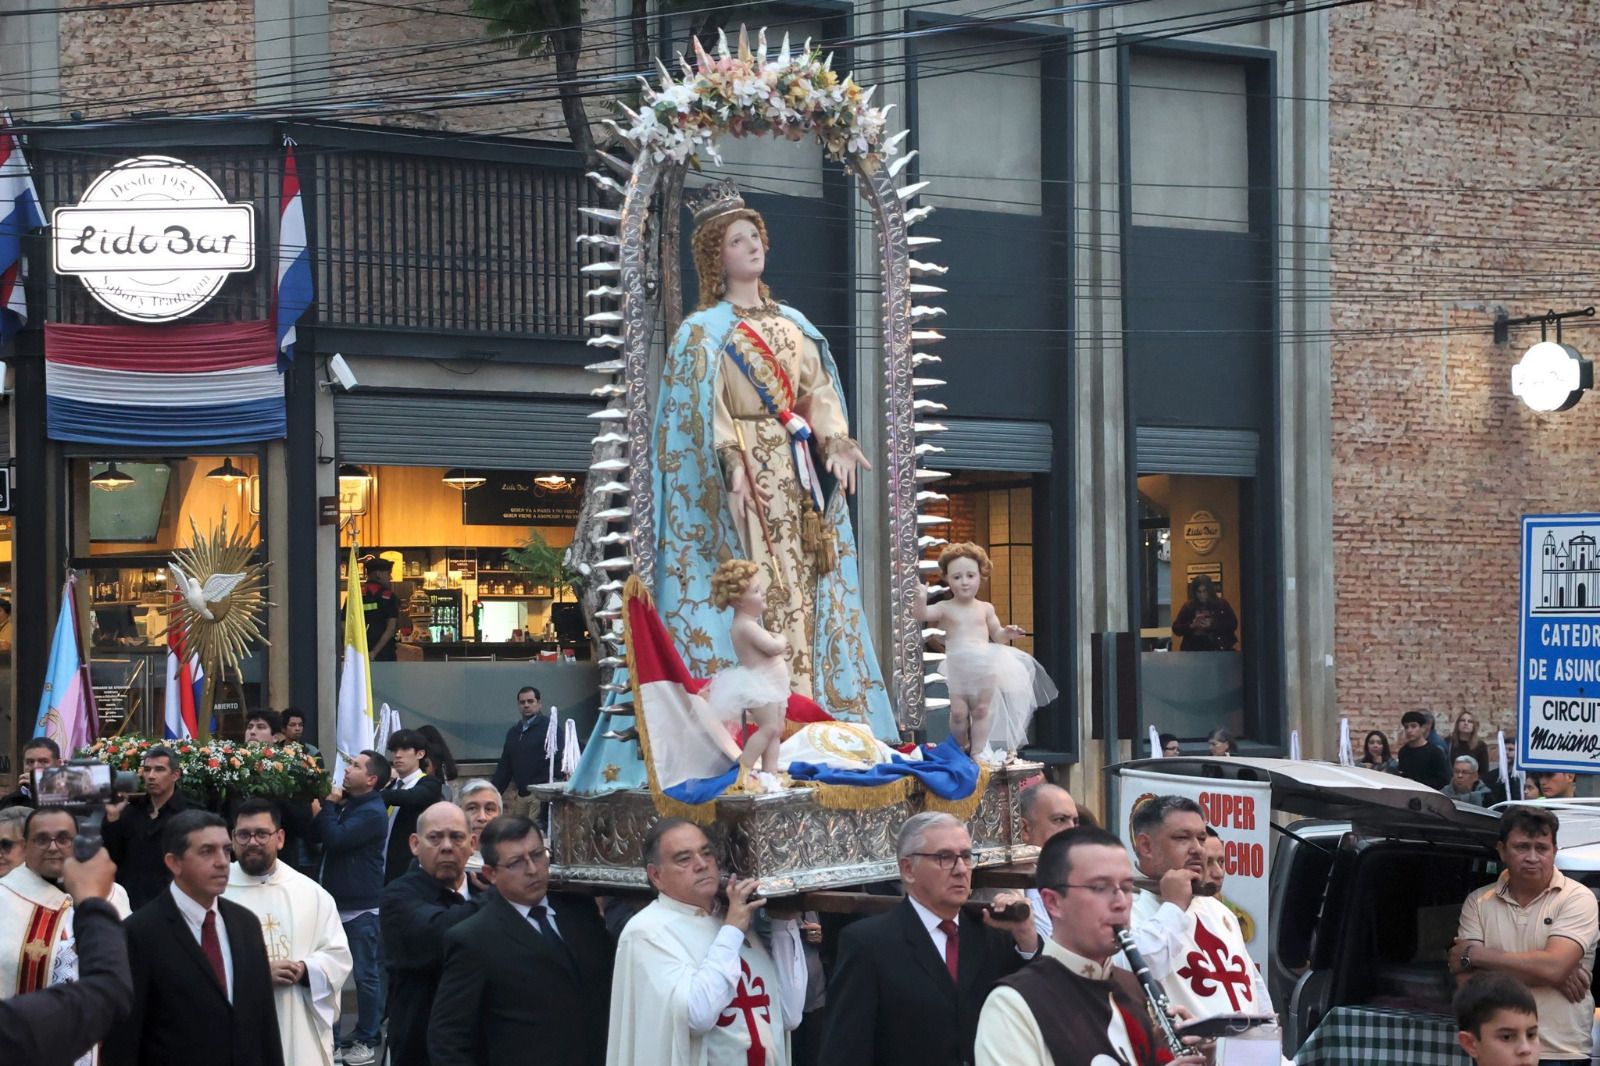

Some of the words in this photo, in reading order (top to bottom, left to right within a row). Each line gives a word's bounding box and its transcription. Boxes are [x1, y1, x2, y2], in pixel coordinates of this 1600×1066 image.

[110, 173, 154, 198] Desde
[70, 225, 158, 255] Lido
[163, 225, 237, 255] Bar
[1541, 623, 1600, 647] CATEDR
[1529, 658, 1548, 681] DE
[213, 702, 239, 710] ABIERTO
[1542, 700, 1600, 723] CIRCUI
[1199, 791, 1255, 830] SUPER
[1221, 840, 1264, 878] CHO
